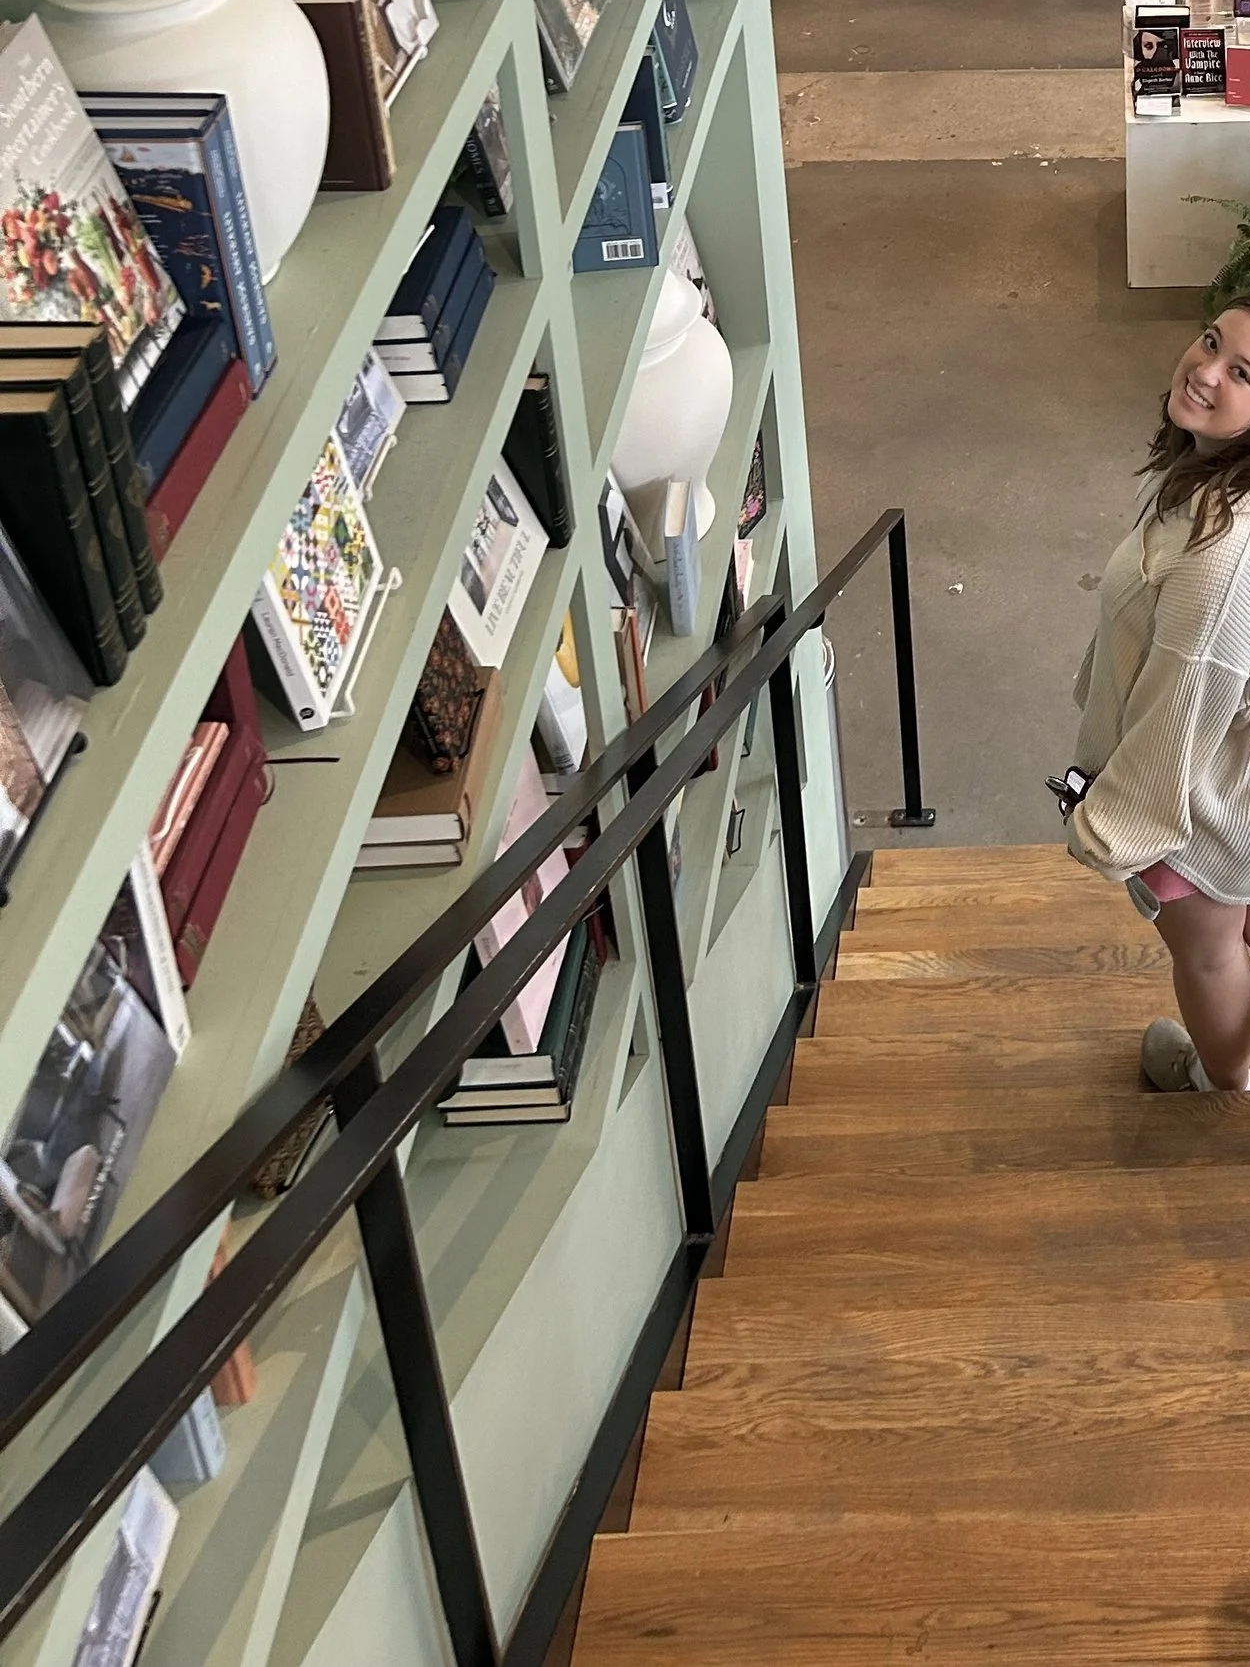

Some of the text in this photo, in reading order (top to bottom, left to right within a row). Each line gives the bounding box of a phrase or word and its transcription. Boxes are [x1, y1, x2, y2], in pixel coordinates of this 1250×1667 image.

[1183, 37, 1221, 49] Interview
[1189, 50, 1205, 59] With
[1185, 58, 1221, 71] Vampire
[1185, 73, 1223, 83] Anne Rice
